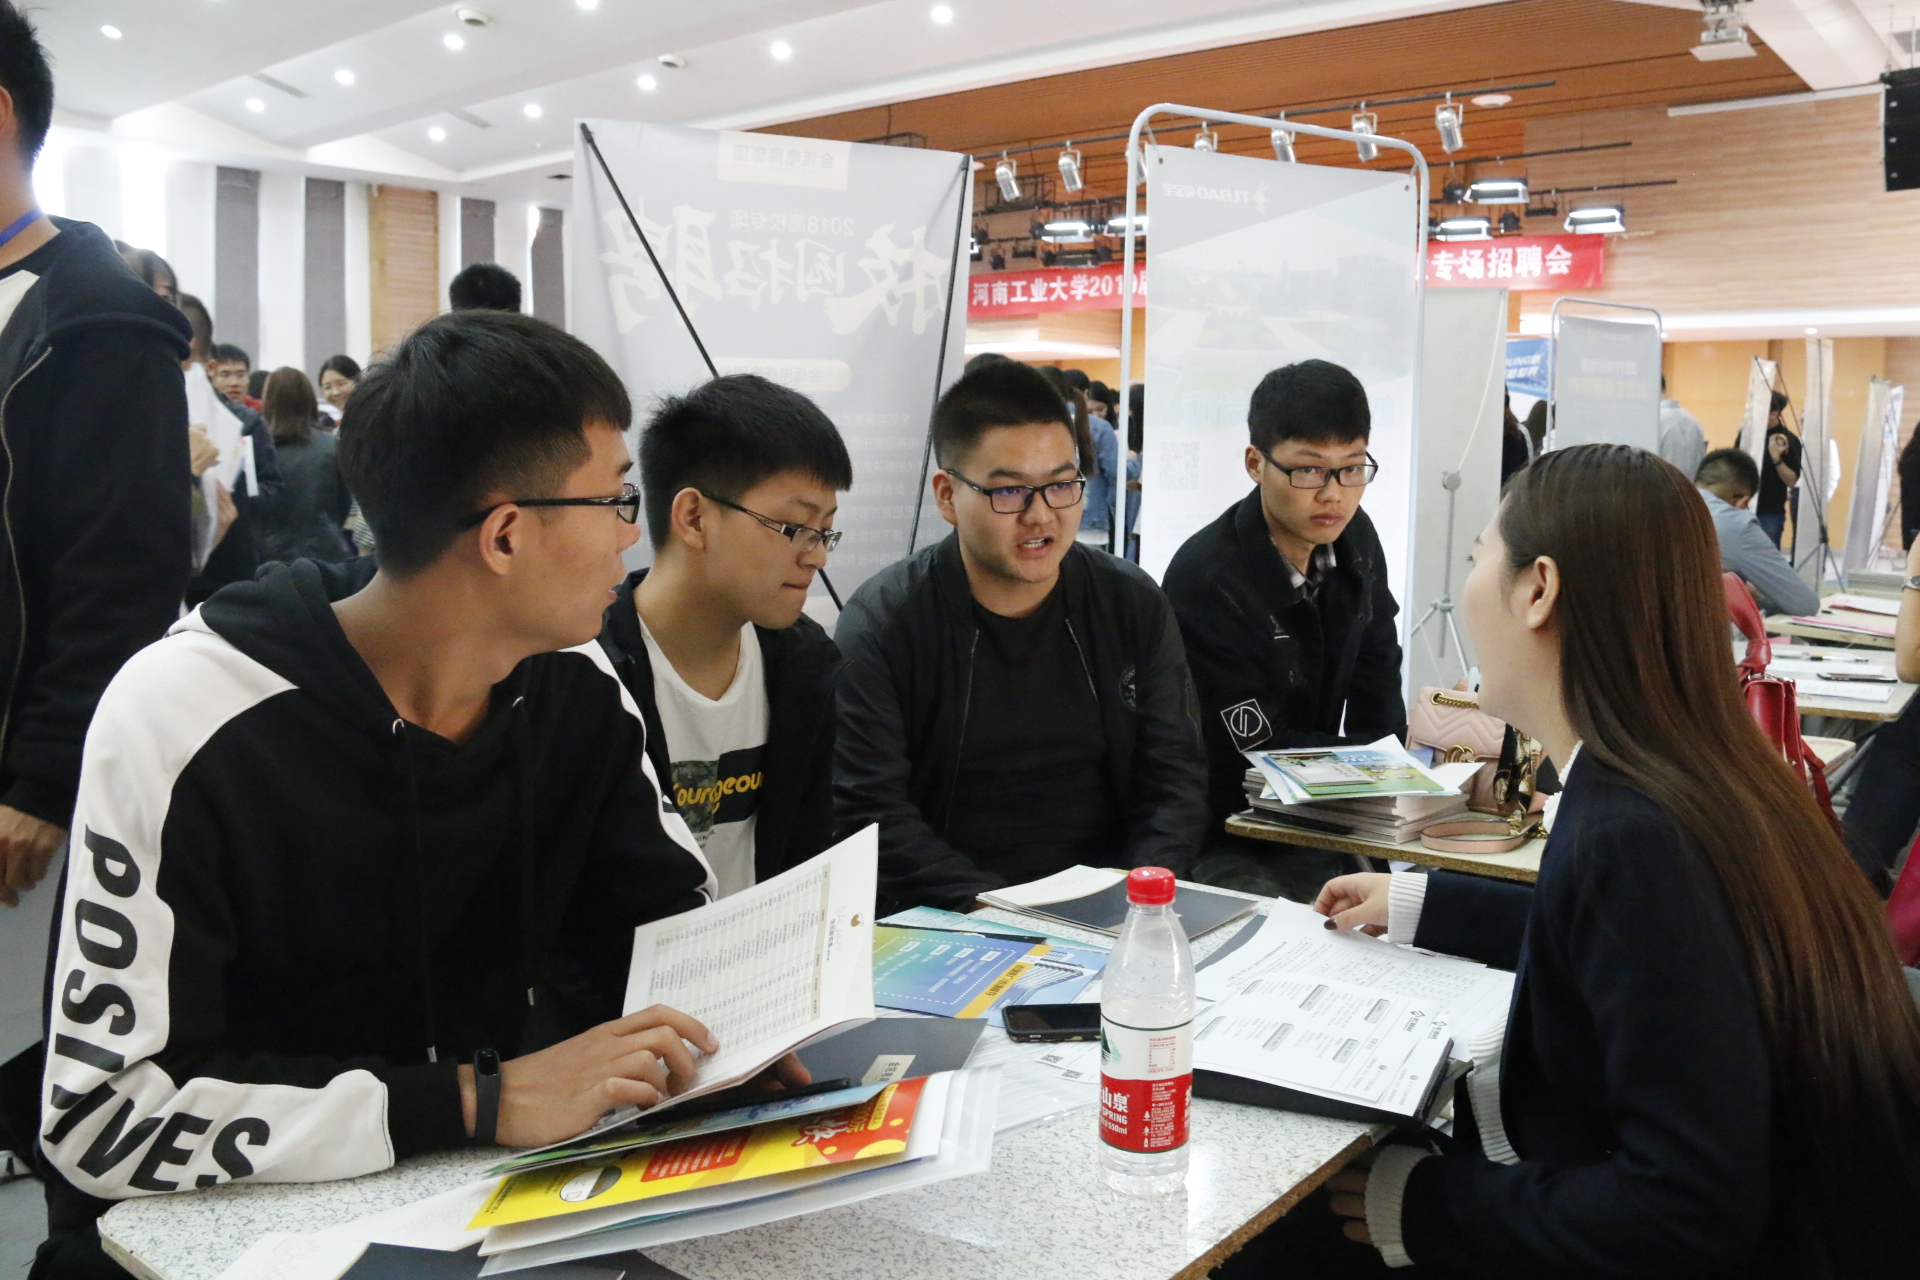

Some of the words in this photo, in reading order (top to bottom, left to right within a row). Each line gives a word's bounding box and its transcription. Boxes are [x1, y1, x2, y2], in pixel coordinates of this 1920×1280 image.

[1416, 243, 1573, 281] 专场招聘会
[672, 771, 763, 819] ourgeou
[1099, 1087, 1129, 1113] 山泉
